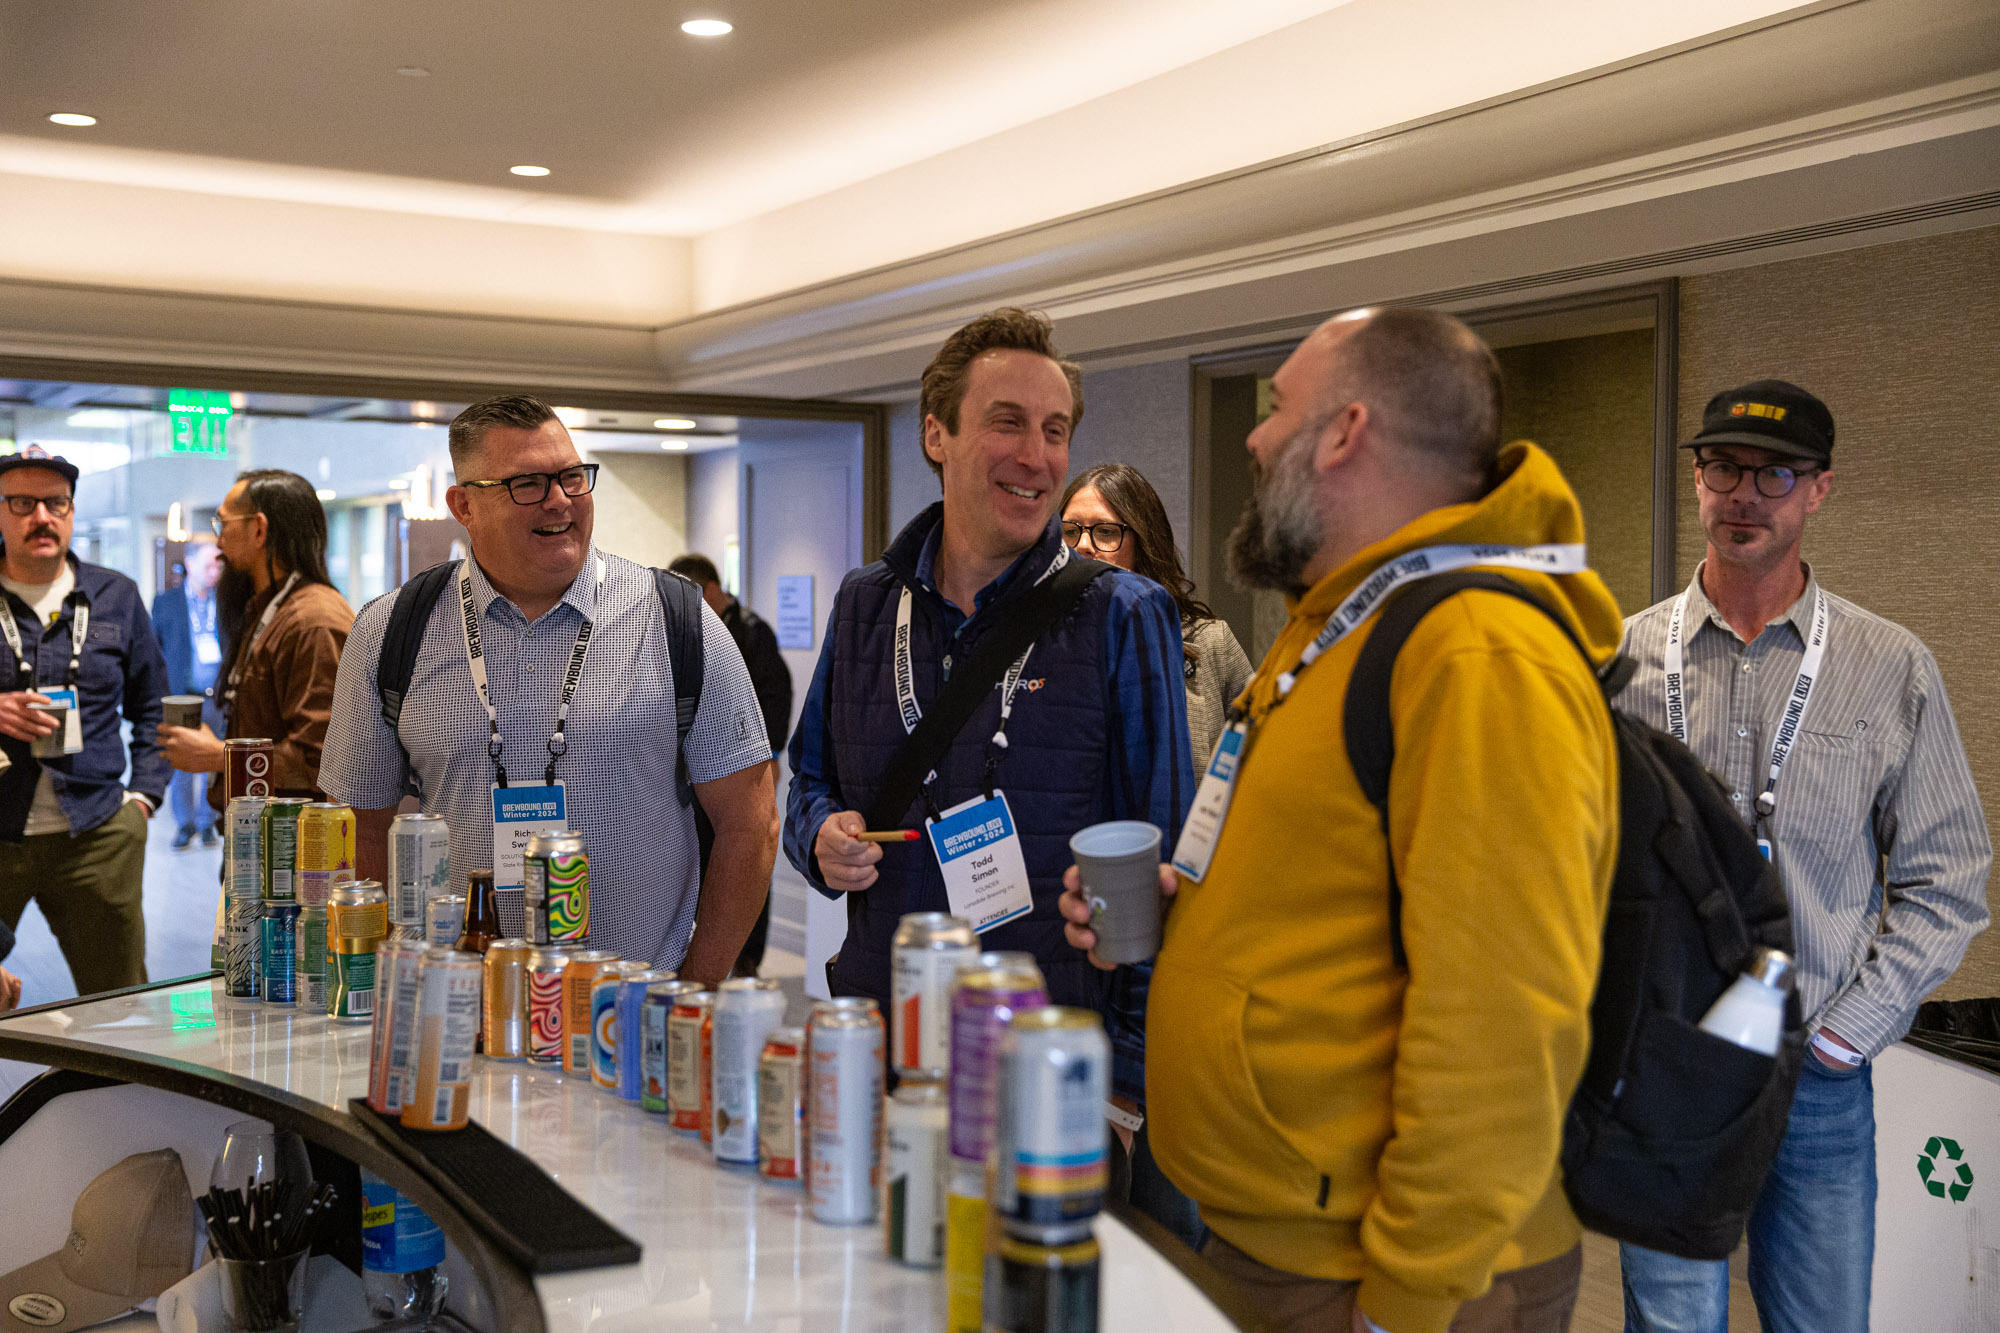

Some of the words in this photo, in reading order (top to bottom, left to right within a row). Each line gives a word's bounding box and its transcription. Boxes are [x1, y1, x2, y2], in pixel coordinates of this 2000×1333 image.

[461, 577, 472, 599] LIVE
[578, 621, 593, 642] LIVE
[1812, 614, 1824, 646] Winter
[1793, 673, 1812, 700] LIVE
[901, 698, 918, 727] LIVE
[542, 802, 557, 810] LIVE
[985, 816, 1003, 832] LIVE
[947, 839, 976, 856] Winter
[984, 827, 1005, 841] 2024
[971, 854, 993, 870] Todd
[971, 866, 998, 883] Simon
[975, 880, 999, 894] FOUNDER
[979, 908, 1008, 924] ATTENDEE
